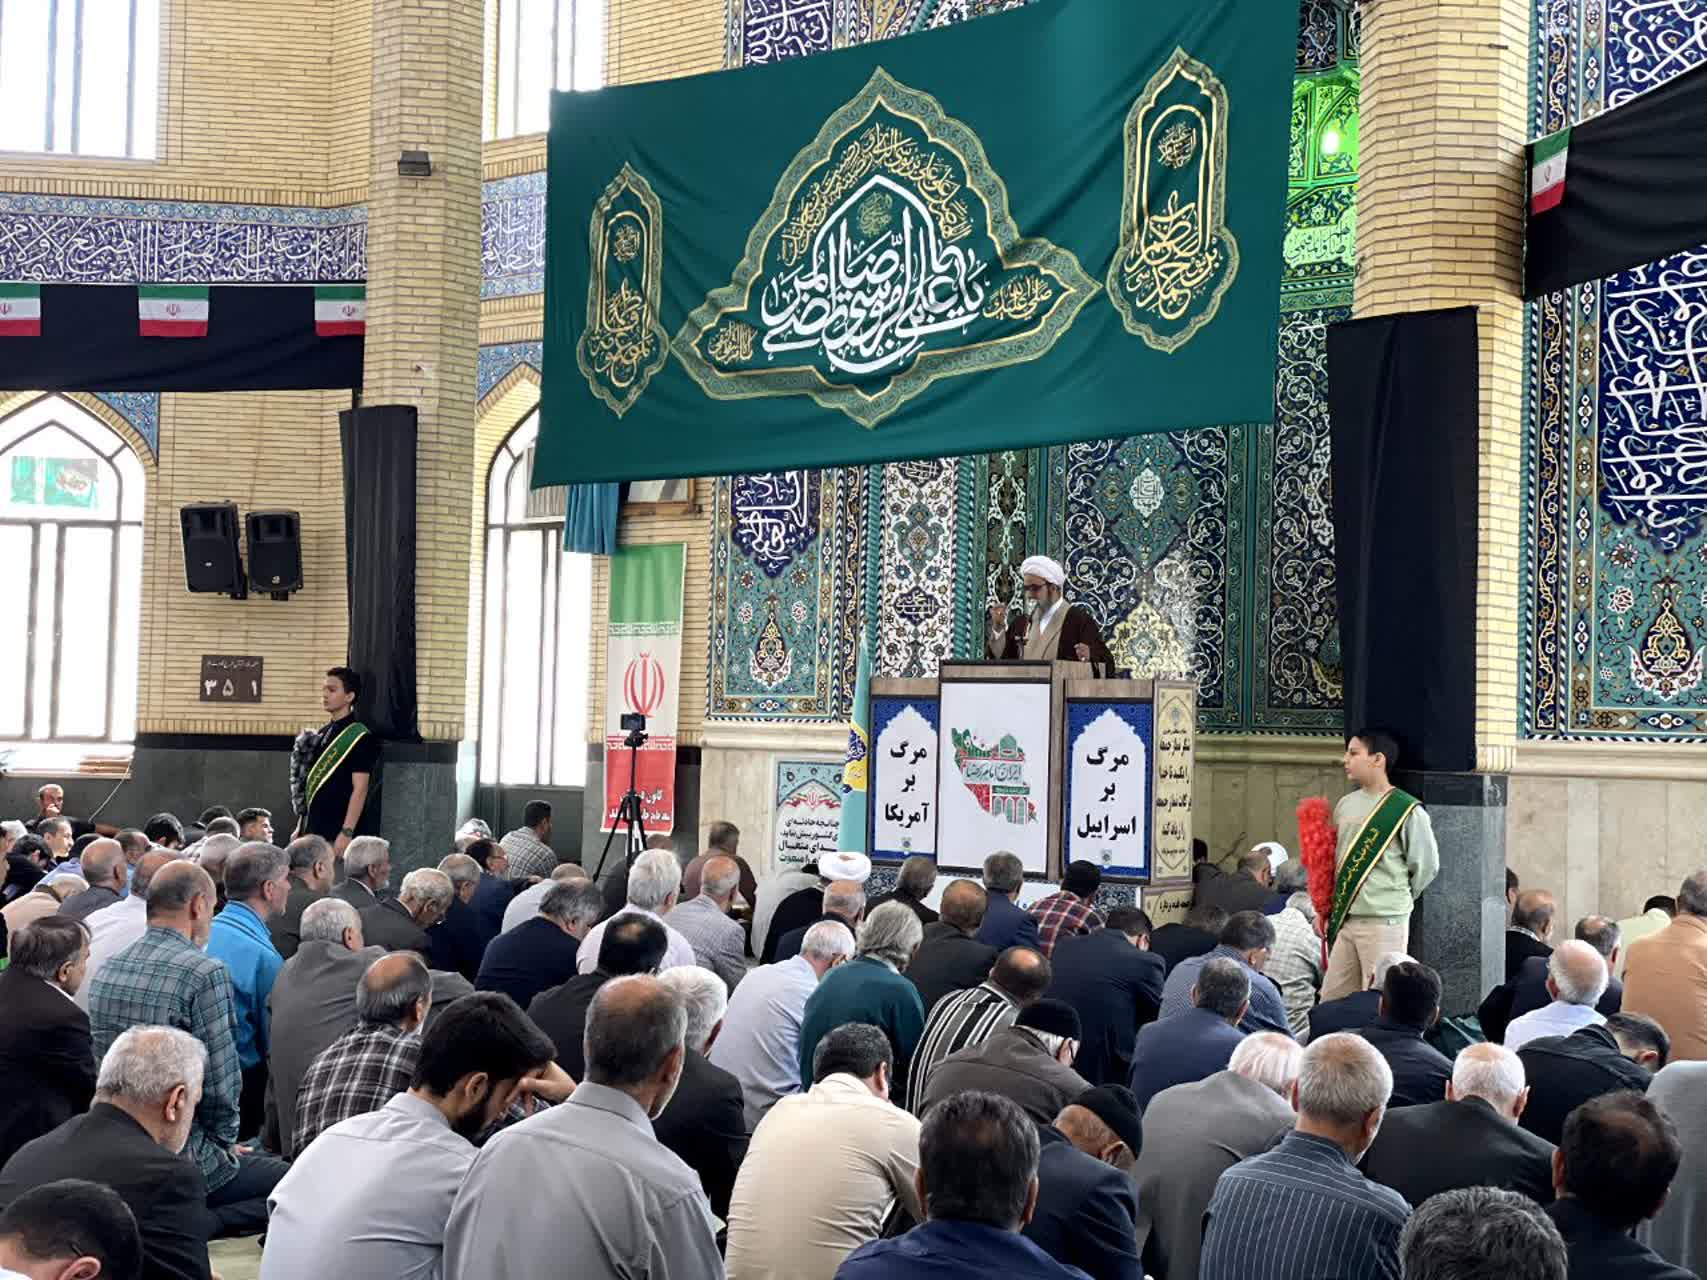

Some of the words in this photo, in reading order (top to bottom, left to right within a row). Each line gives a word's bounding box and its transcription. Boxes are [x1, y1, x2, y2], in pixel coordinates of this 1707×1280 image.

[889, 741, 928, 765] مرگ
[1086, 746, 1129, 772] مرگ
[900, 774, 917, 793] بر
[995, 763, 1022, 781] ایران
[1098, 780, 1117, 803] بر
[884, 802, 930, 829] آمریکا
[1076, 813, 1138, 840] اسراییل
